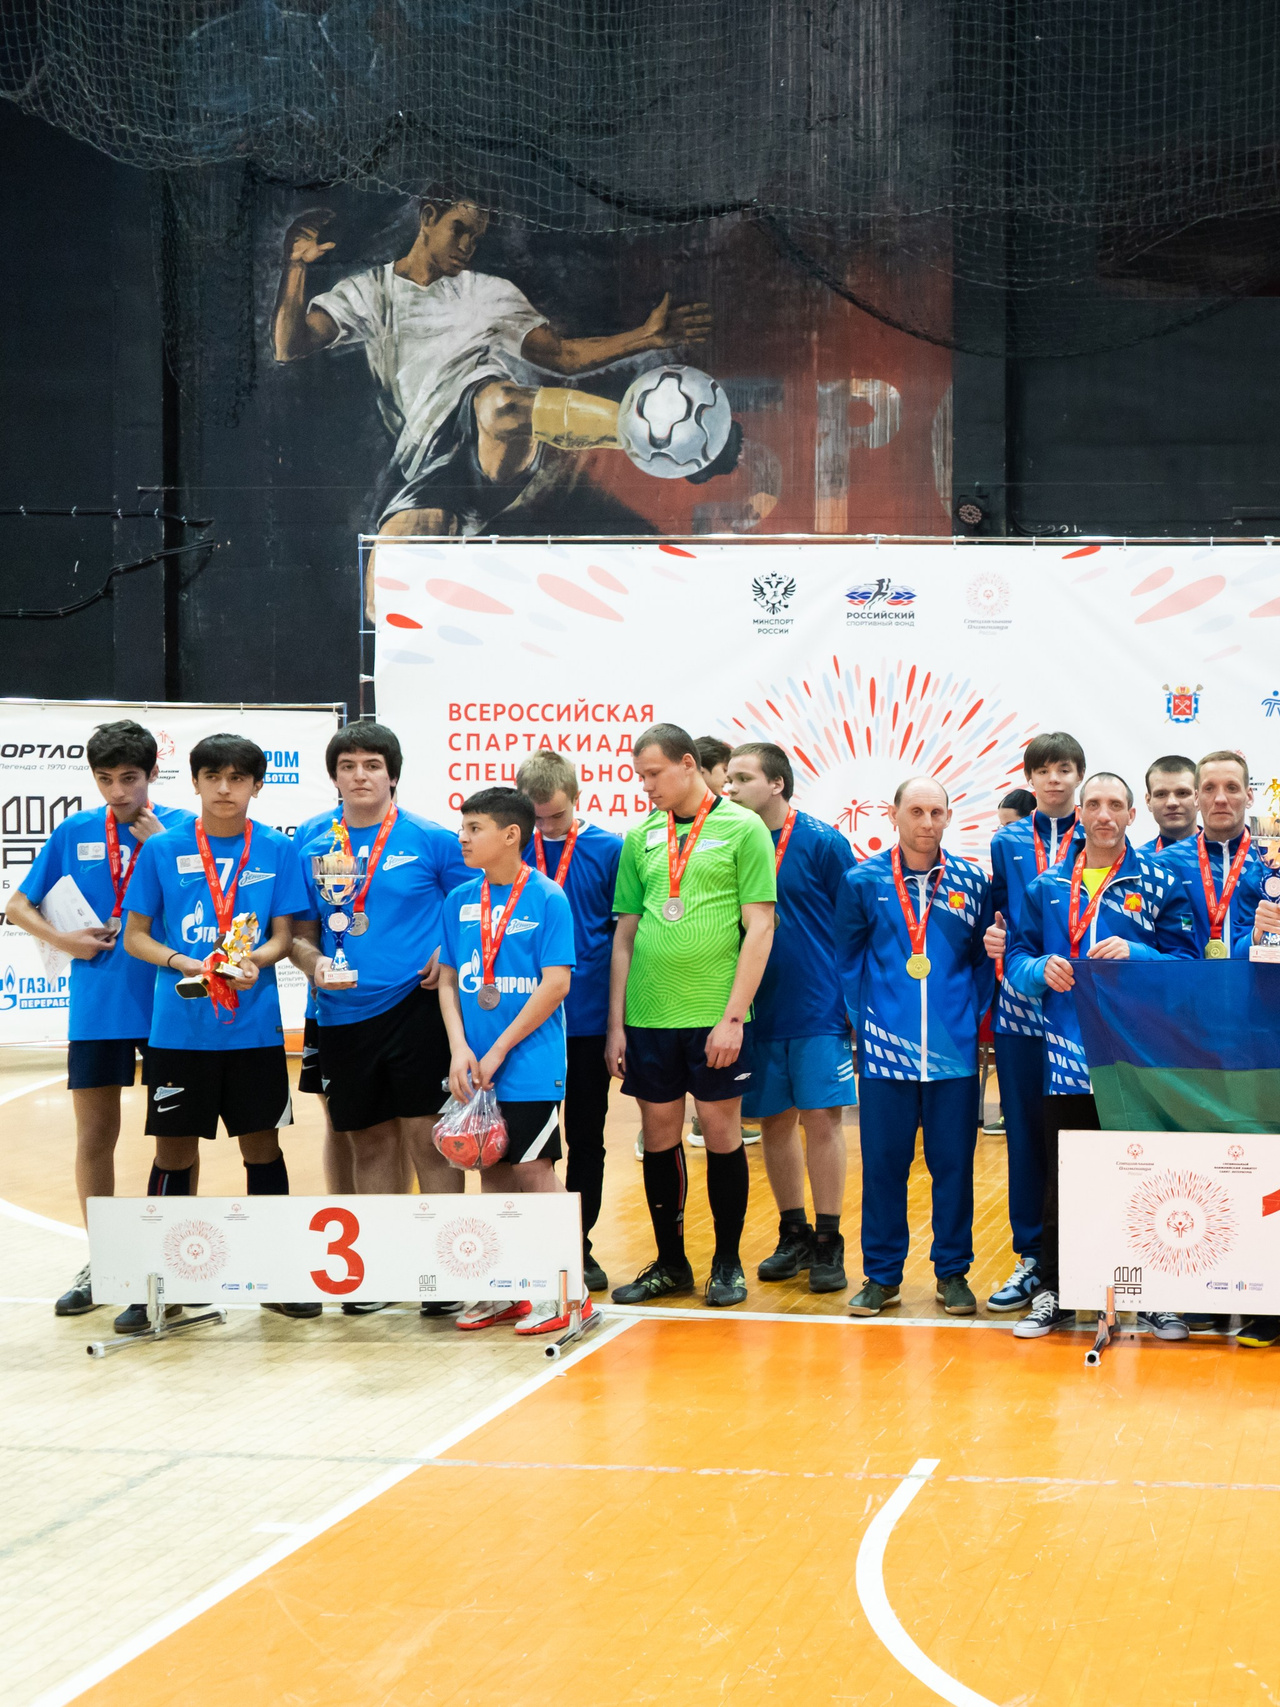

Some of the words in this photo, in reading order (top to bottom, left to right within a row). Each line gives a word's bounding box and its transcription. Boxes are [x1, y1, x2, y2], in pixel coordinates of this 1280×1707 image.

[846, 611, 915, 619] РОССИЙСКИЙ
[448, 698, 654, 722] ВСЕРОССИЙСКАЯ
[0, 744, 85, 759] ОРТЛО
[448, 733, 634, 757] СПАРТАКИАД
[215, 857, 234, 892] 7
[308, 1207, 365, 1295] 3
[1114, 1266, 1142, 1282] ДОМ
